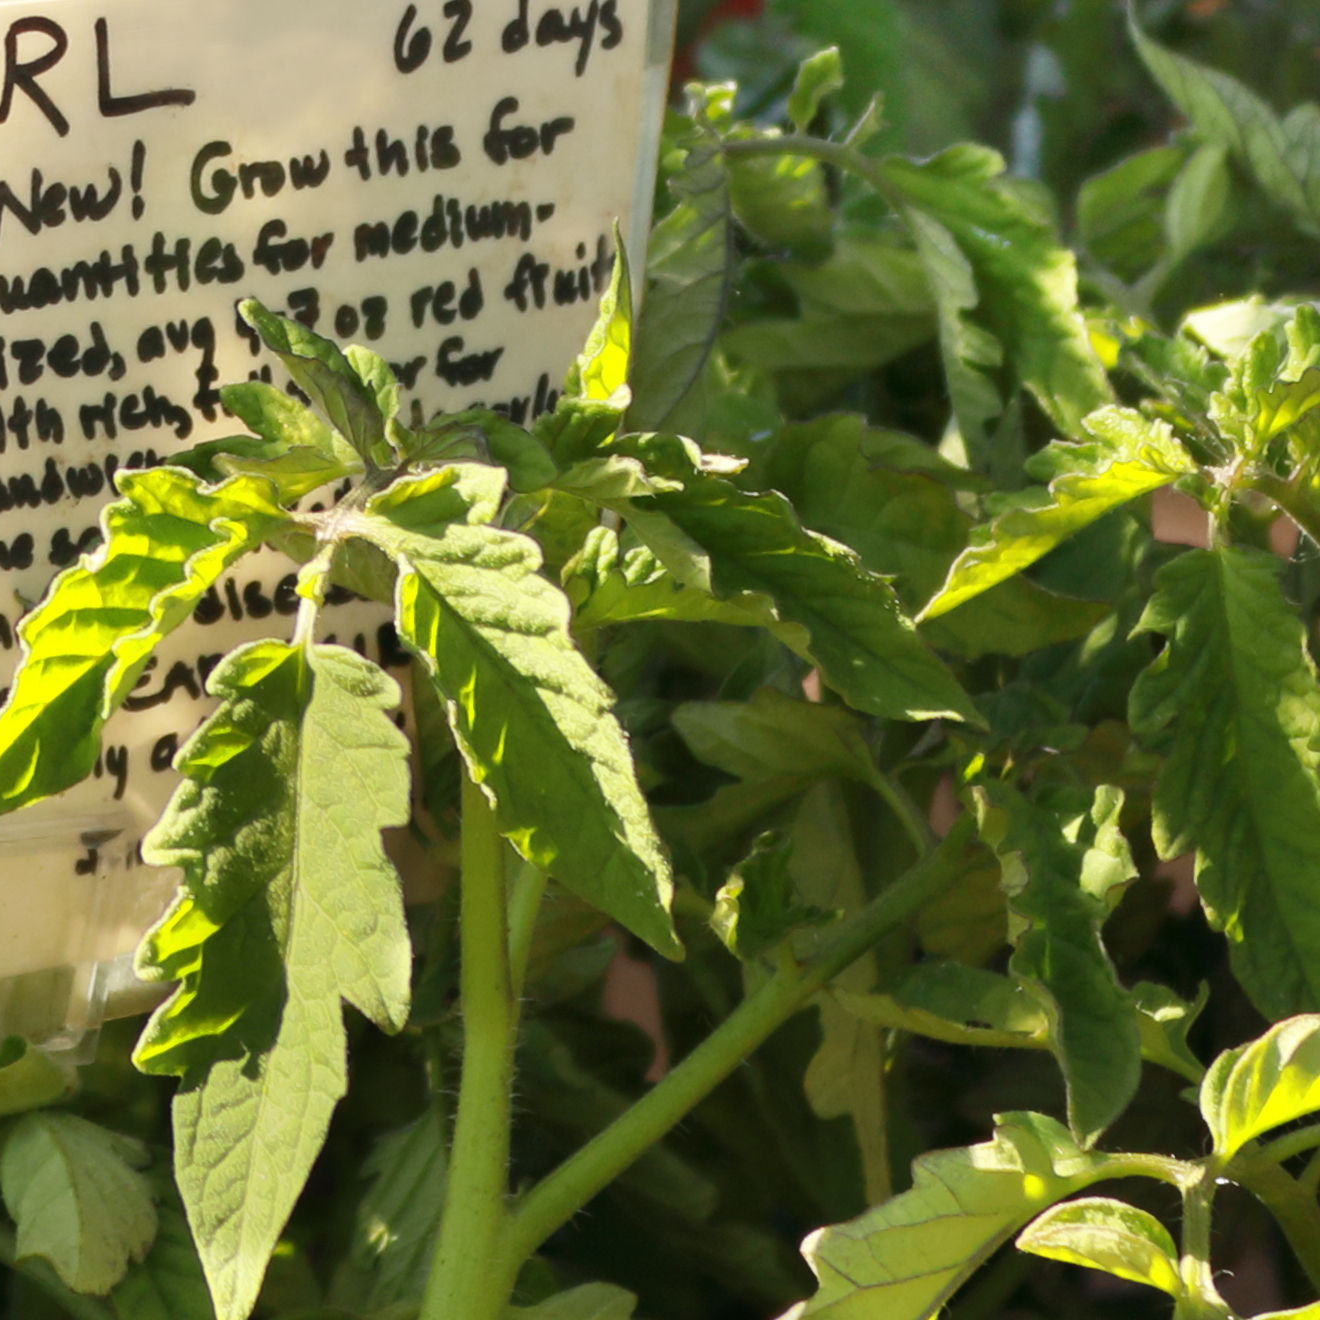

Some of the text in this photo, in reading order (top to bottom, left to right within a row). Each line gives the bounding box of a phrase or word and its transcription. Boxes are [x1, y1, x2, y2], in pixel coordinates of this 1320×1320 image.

[190, 140, 330, 214] Grow
[344, 124, 461, 181] this
[483, 95, 575, 166] for
[252, 218, 335, 275] for
[410, 268, 484, 331] red
[435, 335, 505, 388] for
